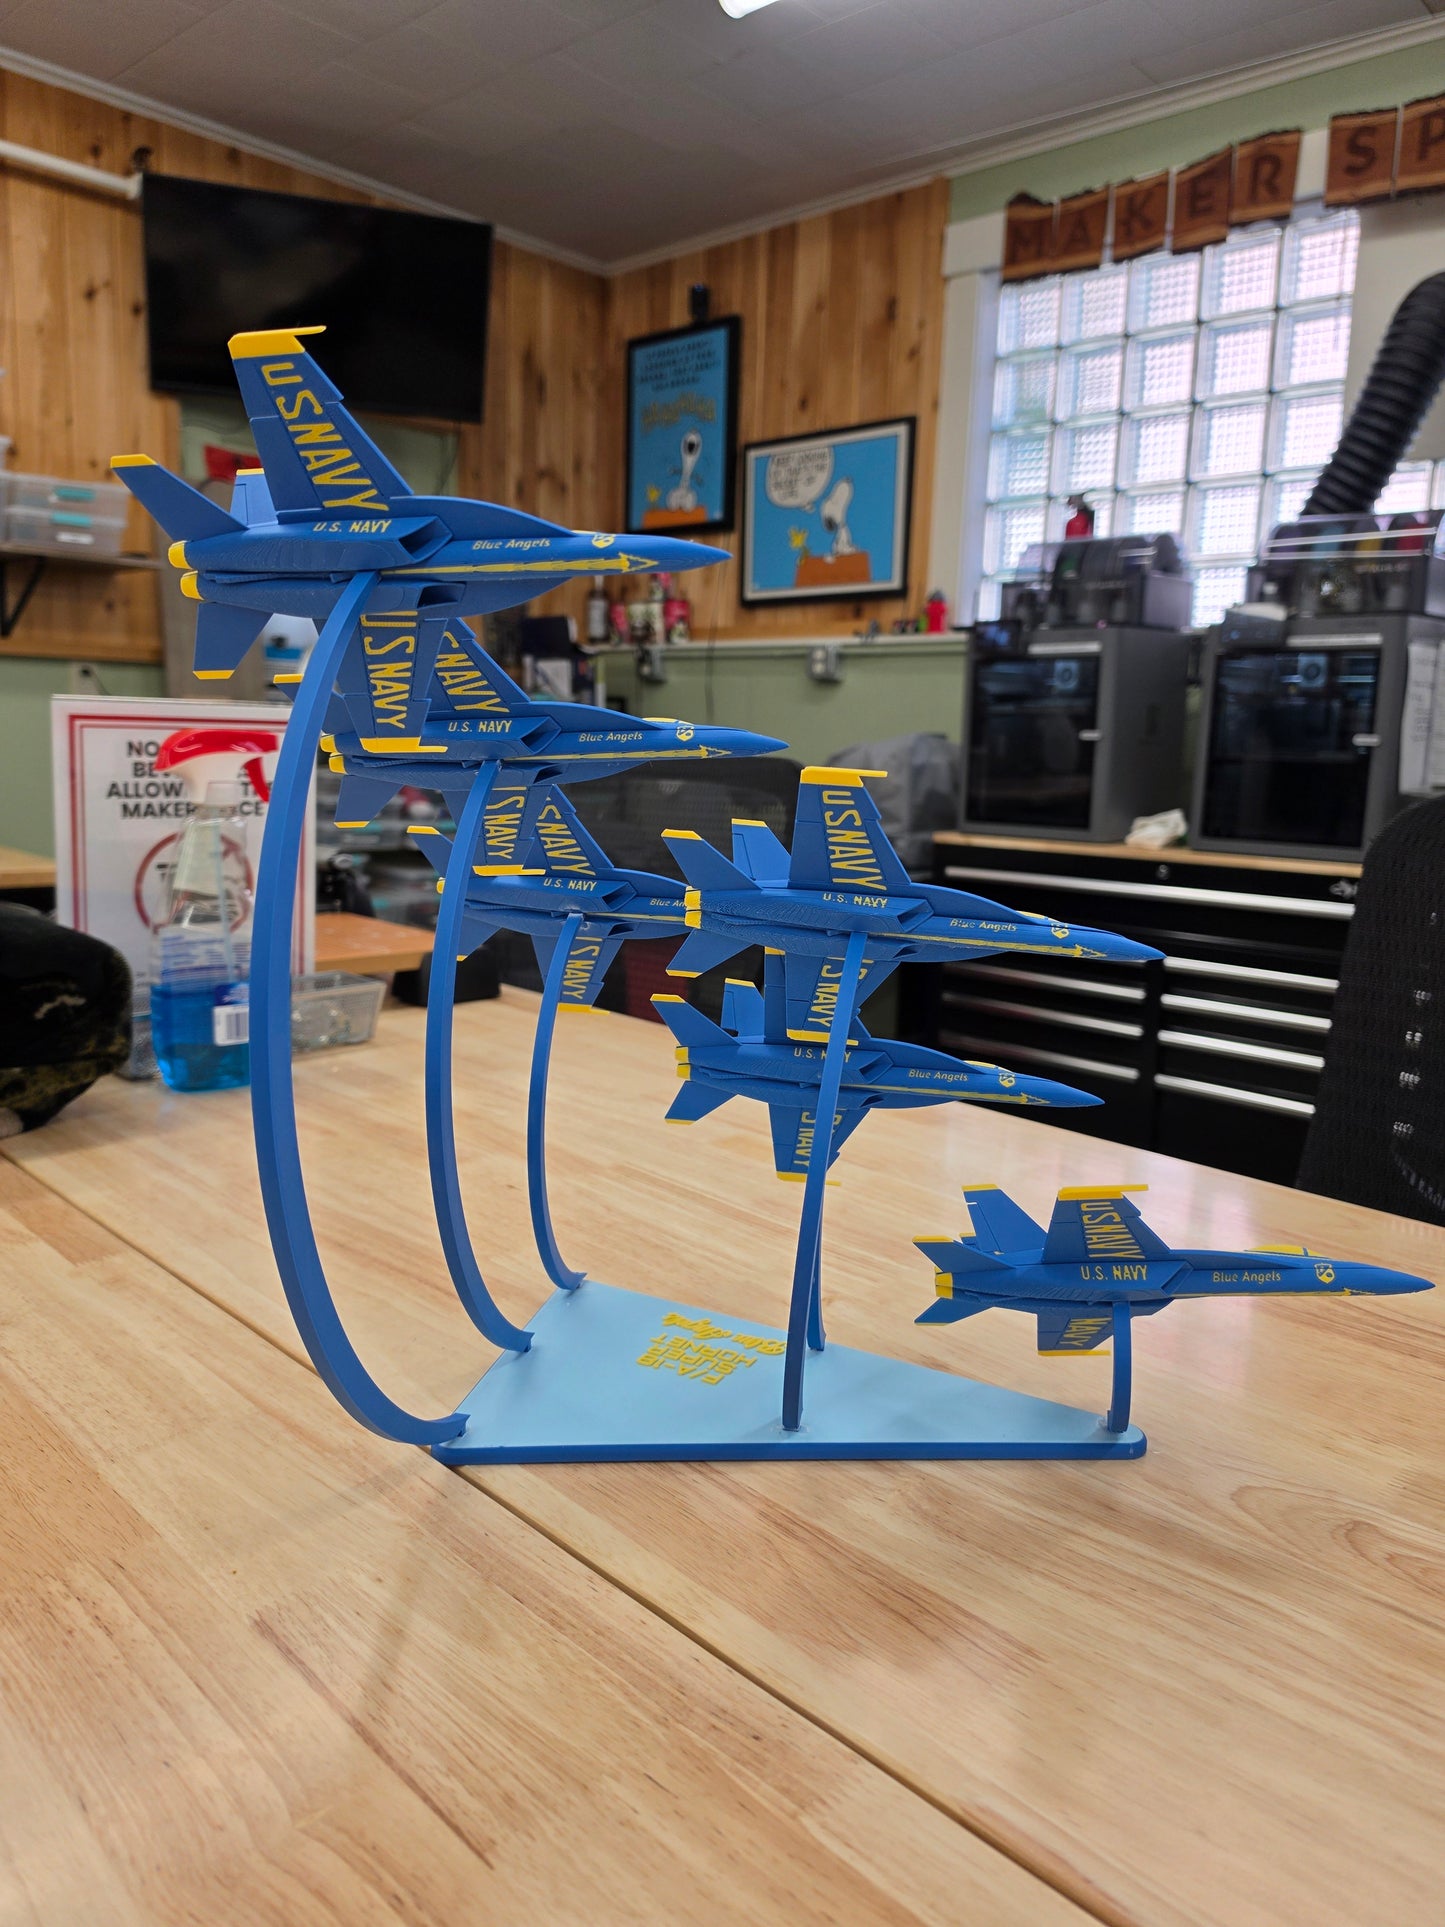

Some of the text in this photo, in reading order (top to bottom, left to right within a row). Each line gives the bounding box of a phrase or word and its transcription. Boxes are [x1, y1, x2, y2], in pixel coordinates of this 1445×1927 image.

[1011, 153, 1284, 266] MAKER
[312, 519, 392, 534] U.S. NAVY
[472, 538, 551, 552] Blue Angels
[448, 720, 513, 733] U.S. NAVY
[578, 730, 643, 743] Blue Angels
[107, 781, 184, 798] ALLOW
[568, 880, 597, 891] NAVY
[650, 898, 671, 907] Blue
[823, 893, 888, 908] U.S. NAVY
[949, 917, 1017, 933] Blue Angels
[794, 1047, 816, 1059] U.S.
[908, 1068, 968, 1083] Blue Angels
[1080, 1264, 1148, 1281] U.S. NAVY
[1212, 1270, 1281, 1285] Blue Angels
[650, 1333, 758, 1368] HORNET
[646, 1344, 737, 1375] SUPER
